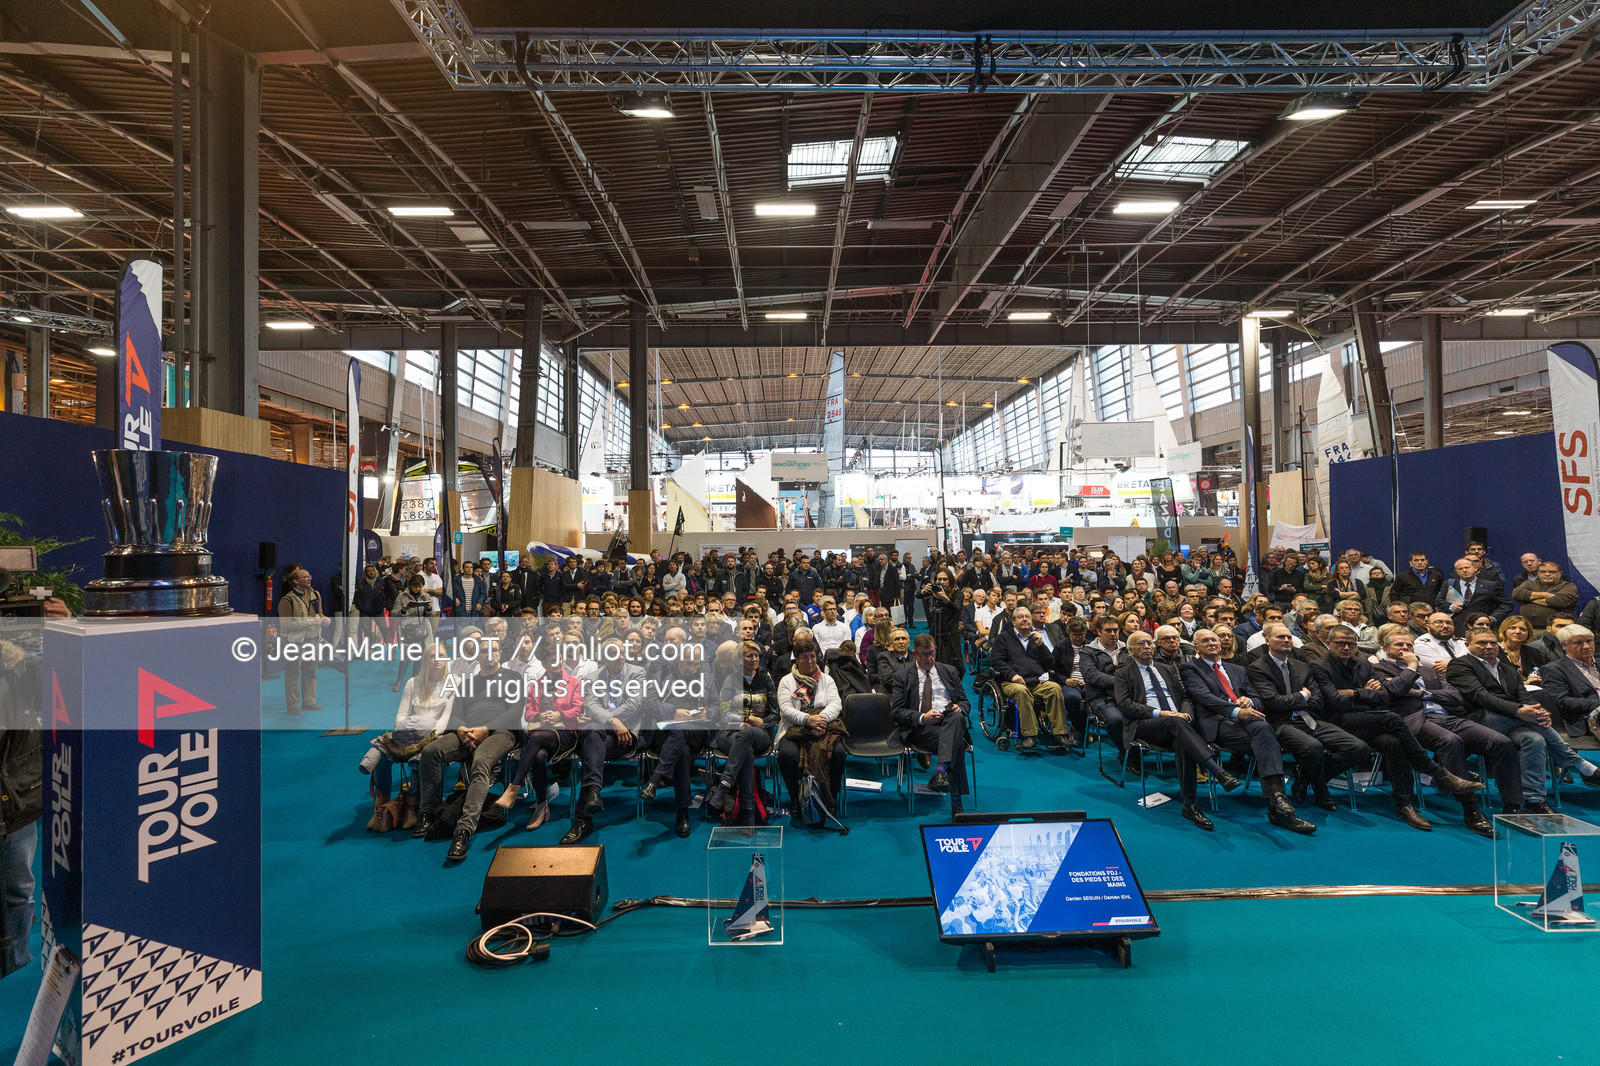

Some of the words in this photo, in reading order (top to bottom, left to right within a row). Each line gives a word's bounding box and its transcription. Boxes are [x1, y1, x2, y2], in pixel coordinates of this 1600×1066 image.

[827, 398, 838, 406] FRA
[1324, 442, 1349, 458] FRA
[1559, 430, 1593, 516] SFS
[401, 500, 432, 509] 2387
[51, 752, 64, 879] TOUR
[60, 742, 72, 872] VOILE
[137, 748, 179, 883] TOUR
[180, 728, 218, 854] VOILE
[935, 837, 965, 846] TOUR
[940, 844, 970, 853] VOILE
[110, 996, 241, 1065] #TOURVOILE
